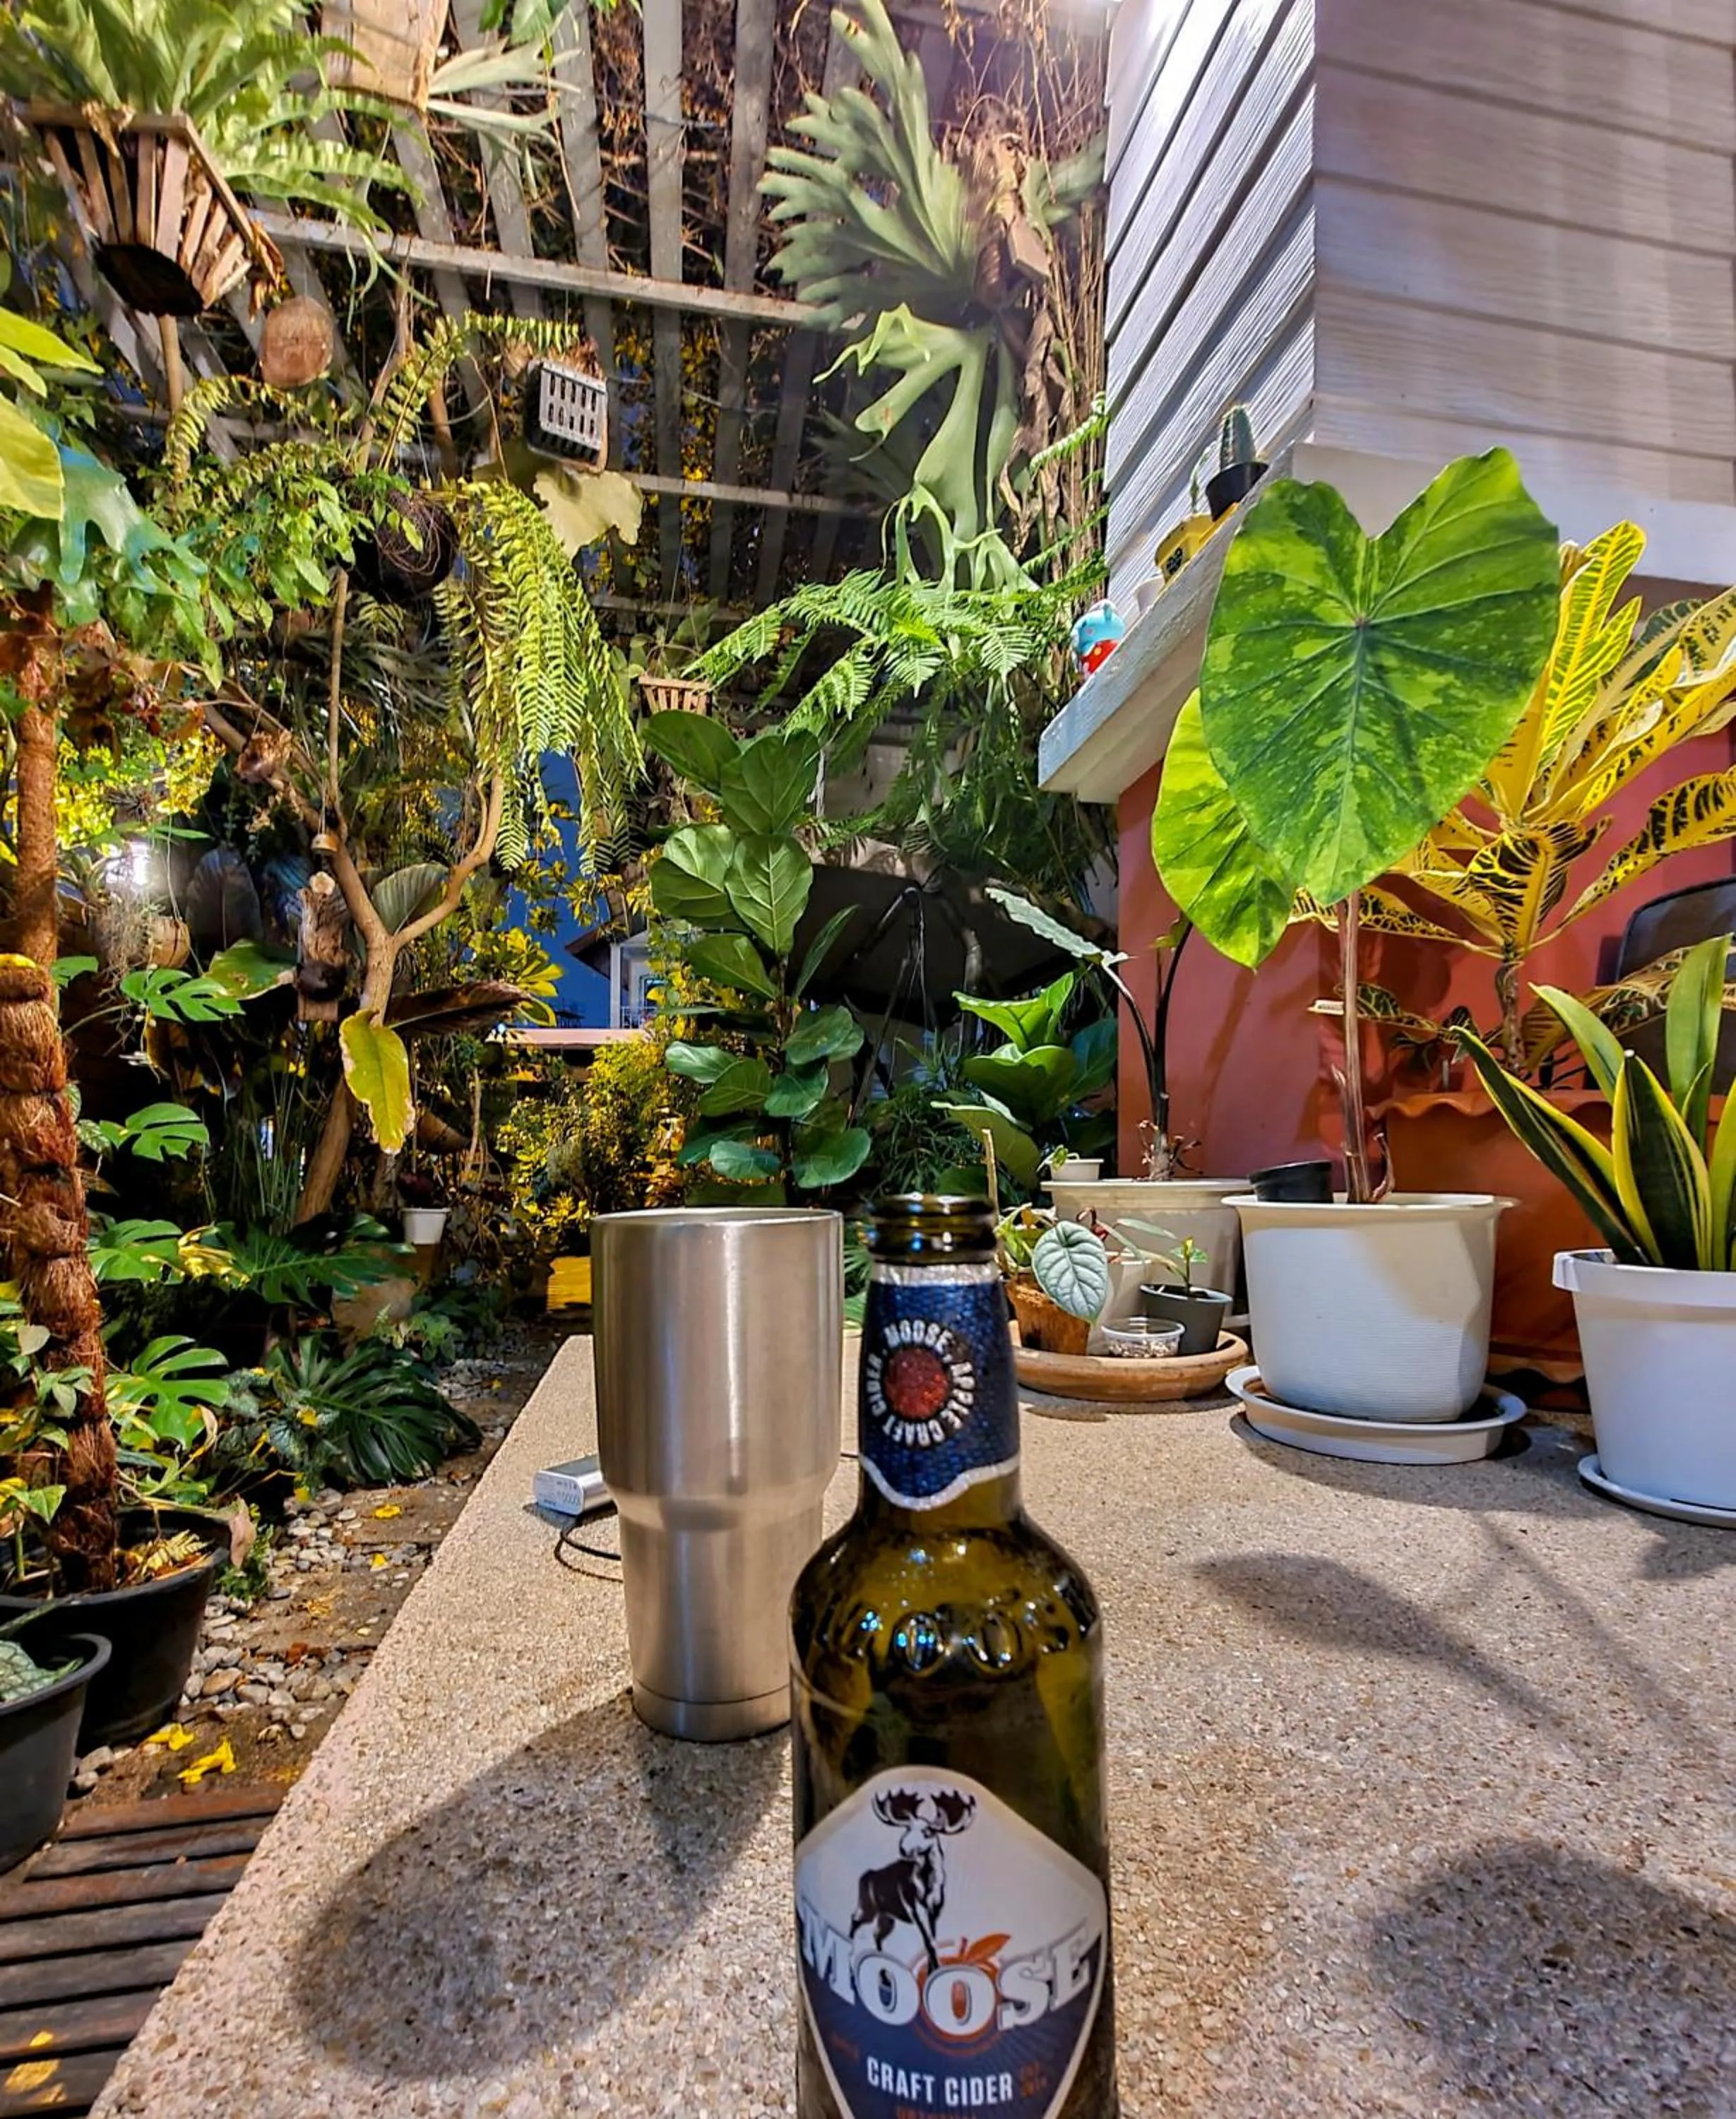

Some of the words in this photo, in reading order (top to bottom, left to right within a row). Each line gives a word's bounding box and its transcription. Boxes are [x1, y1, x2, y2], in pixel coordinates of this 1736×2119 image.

[939, 1361, 975, 1430] APPLE
[883, 1415, 946, 1447] CRAFT
[799, 1898, 1091, 2036] MOOSE
[867, 2055, 935, 2103] CRAFT
[944, 2072, 1013, 2107] CIDER
